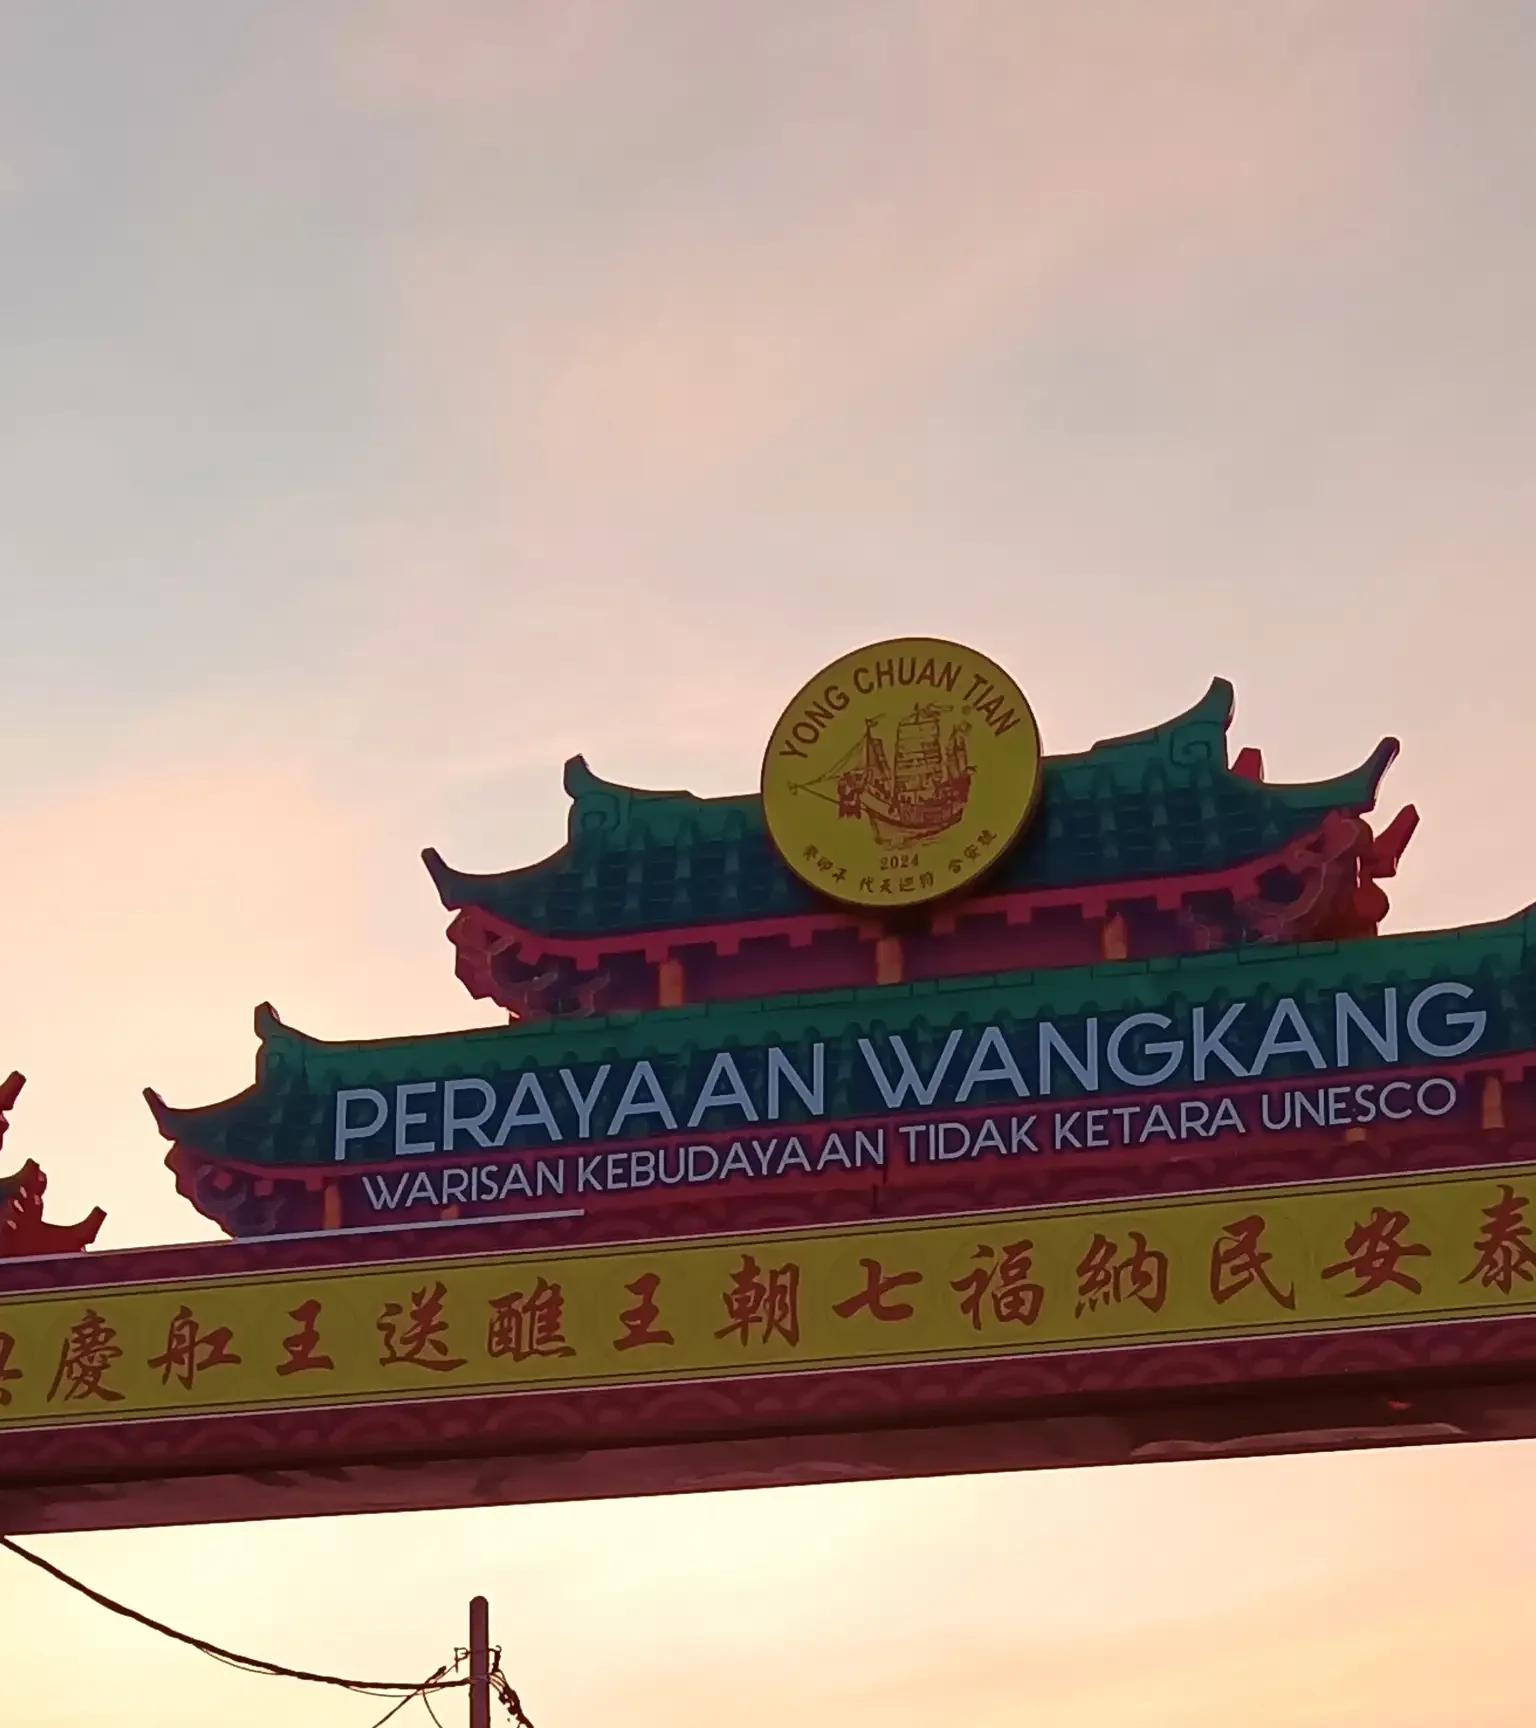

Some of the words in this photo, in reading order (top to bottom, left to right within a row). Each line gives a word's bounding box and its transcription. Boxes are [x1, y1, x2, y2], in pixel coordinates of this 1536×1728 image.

[780, 685, 850, 761] YONG
[854, 657, 963, 695] CHUAN
[962, 672, 1021, 737] TIAN
[880, 853, 920, 871] 2024
[334, 1041, 825, 1160] PERAYAAN
[857, 981, 1487, 1109] WANGKANG
[362, 1160, 565, 1210] WARISAN
[577, 1128, 885, 1192] KEBUDAYAAN
[898, 1115, 1038, 1163] TIDAK
[1055, 1098, 1247, 1150] KETARA
[1261, 1077, 1457, 1129] UNESCO
